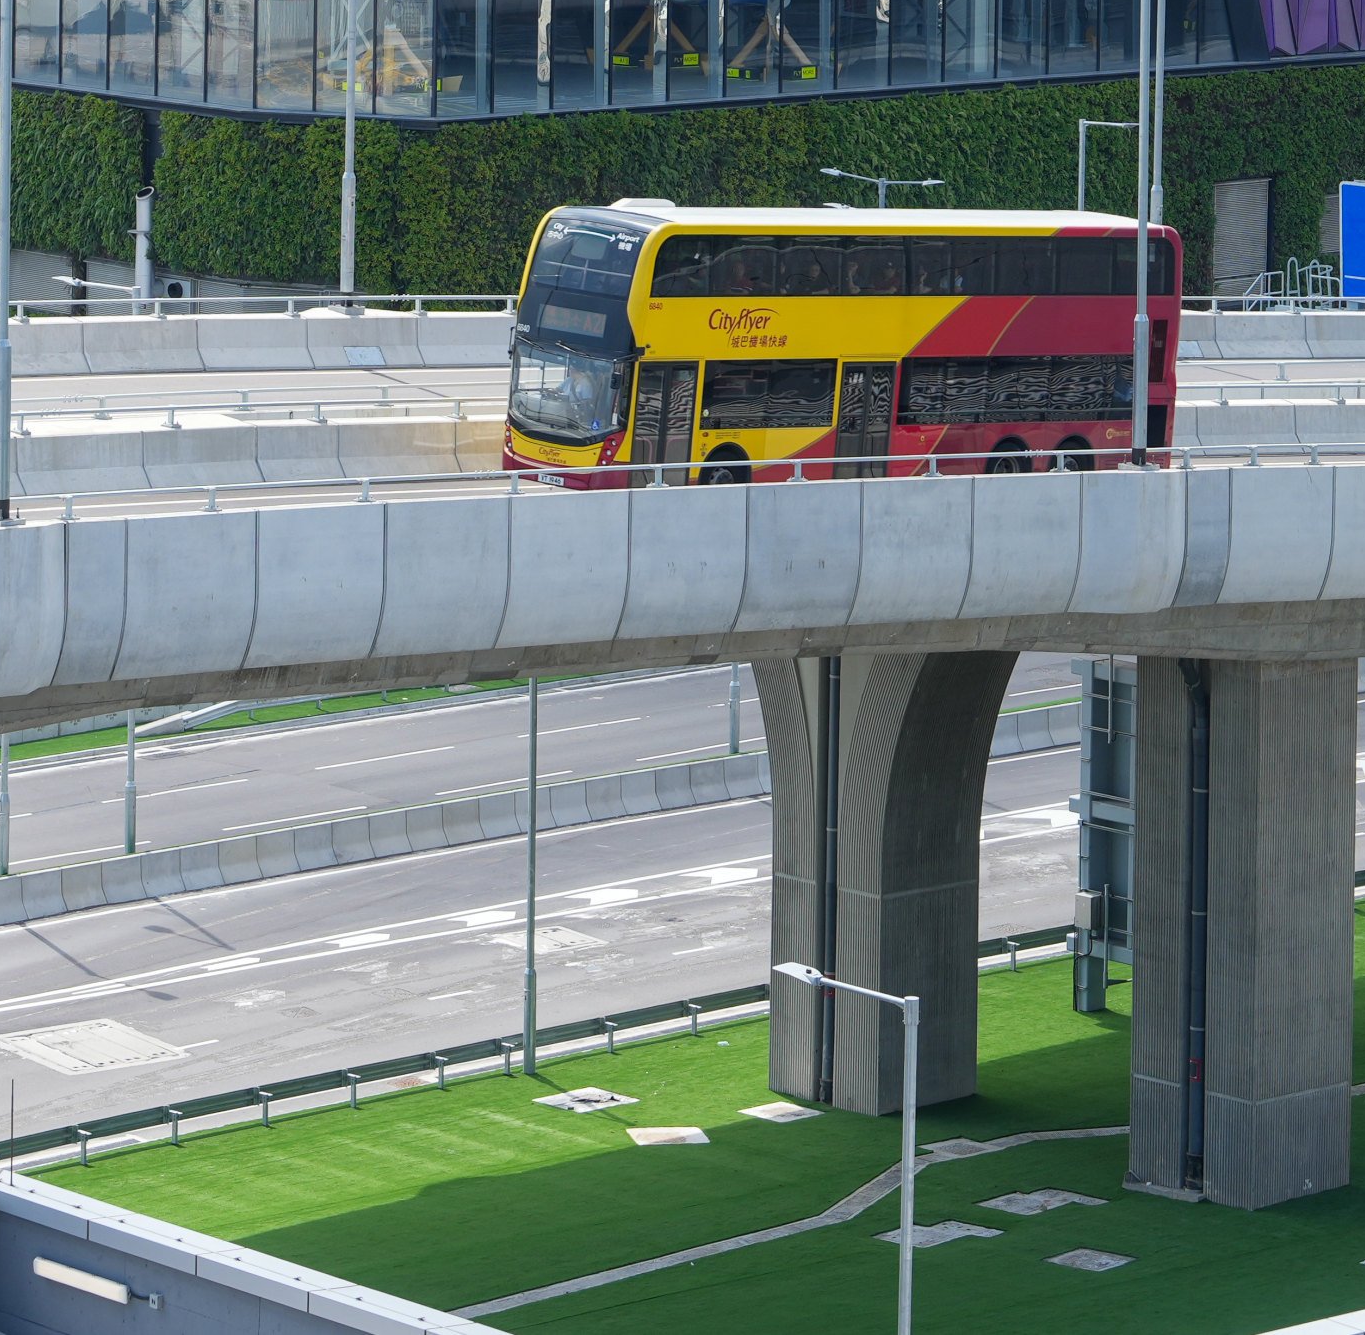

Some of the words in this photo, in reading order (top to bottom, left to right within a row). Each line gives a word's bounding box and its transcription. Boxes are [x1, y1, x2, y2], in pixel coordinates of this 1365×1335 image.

[616, 232, 641, 243] Airport
[649, 303, 663, 311] 6840
[517, 323, 531, 333] 6840
